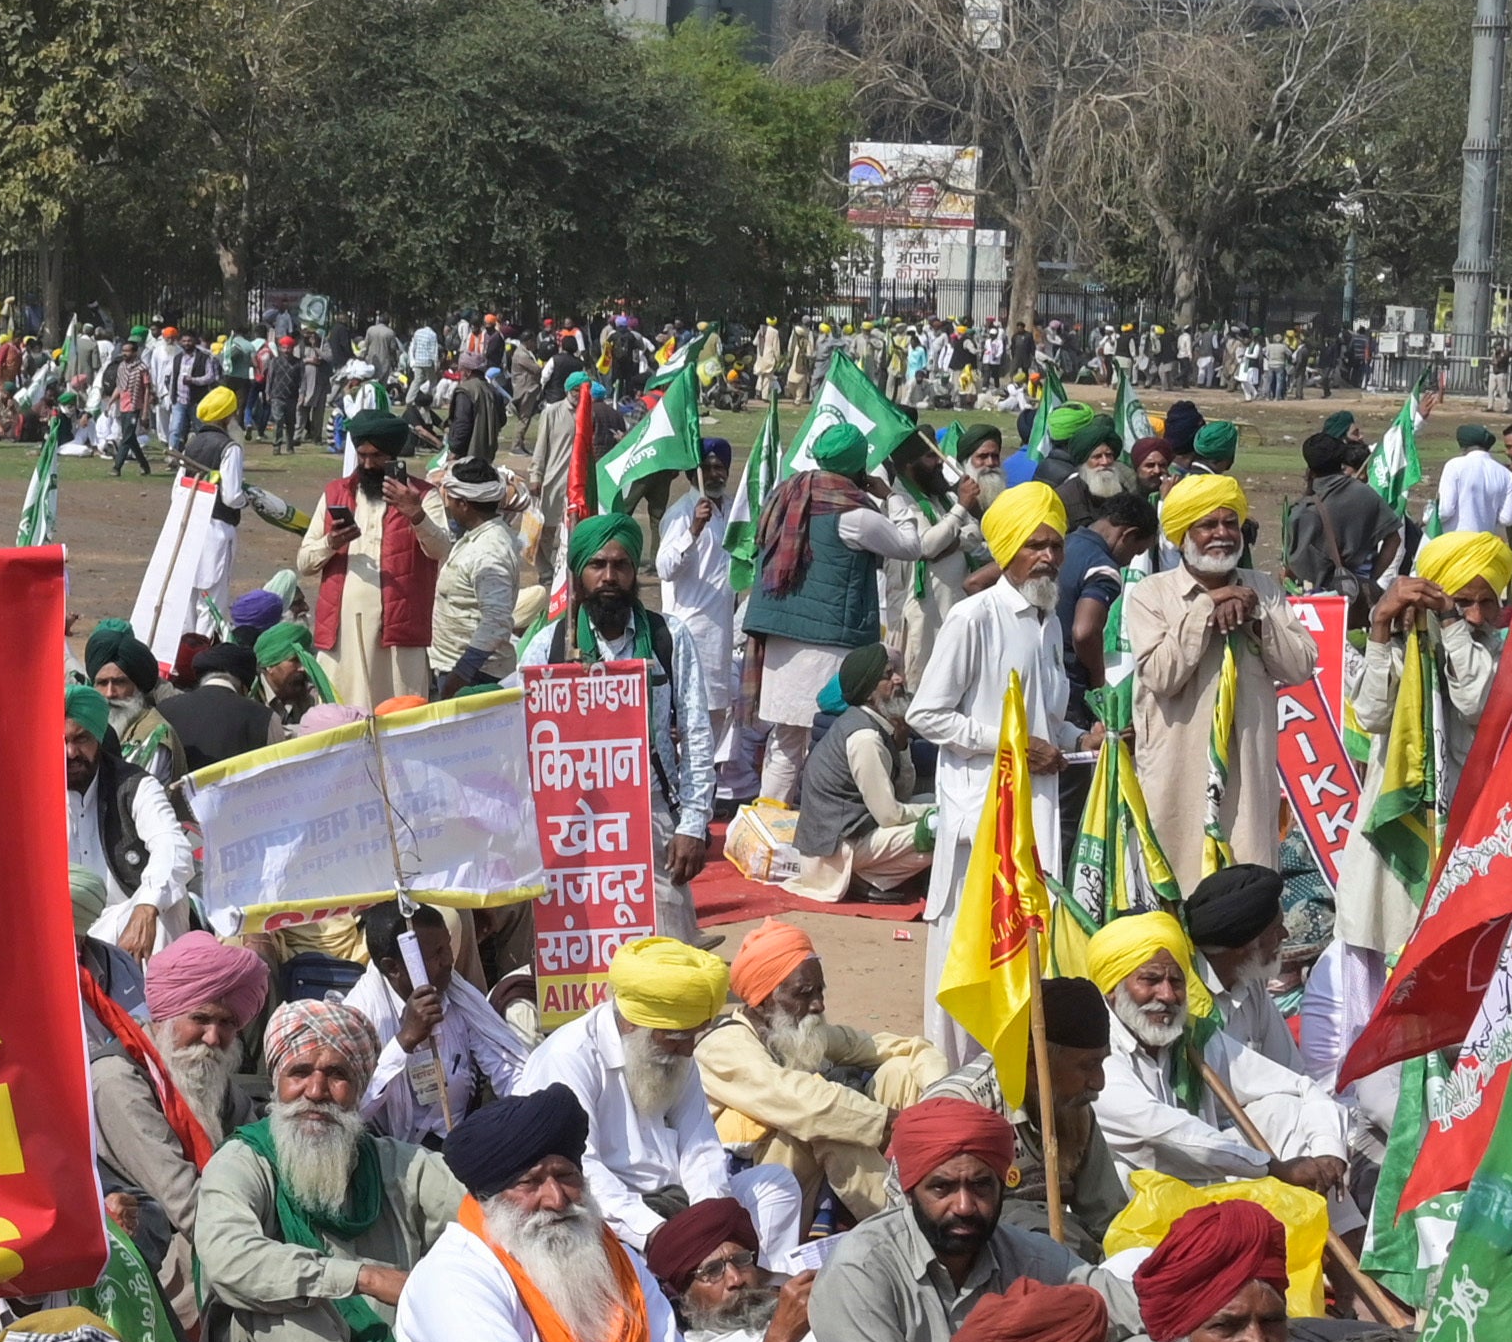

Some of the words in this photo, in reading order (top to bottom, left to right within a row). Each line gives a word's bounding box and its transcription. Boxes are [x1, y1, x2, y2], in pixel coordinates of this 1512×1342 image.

[528, 667, 573, 714] ऑल
[575, 666, 642, 717] इण्डिया
[529, 719, 643, 793] किसान
[546, 797, 631, 857] खेत
